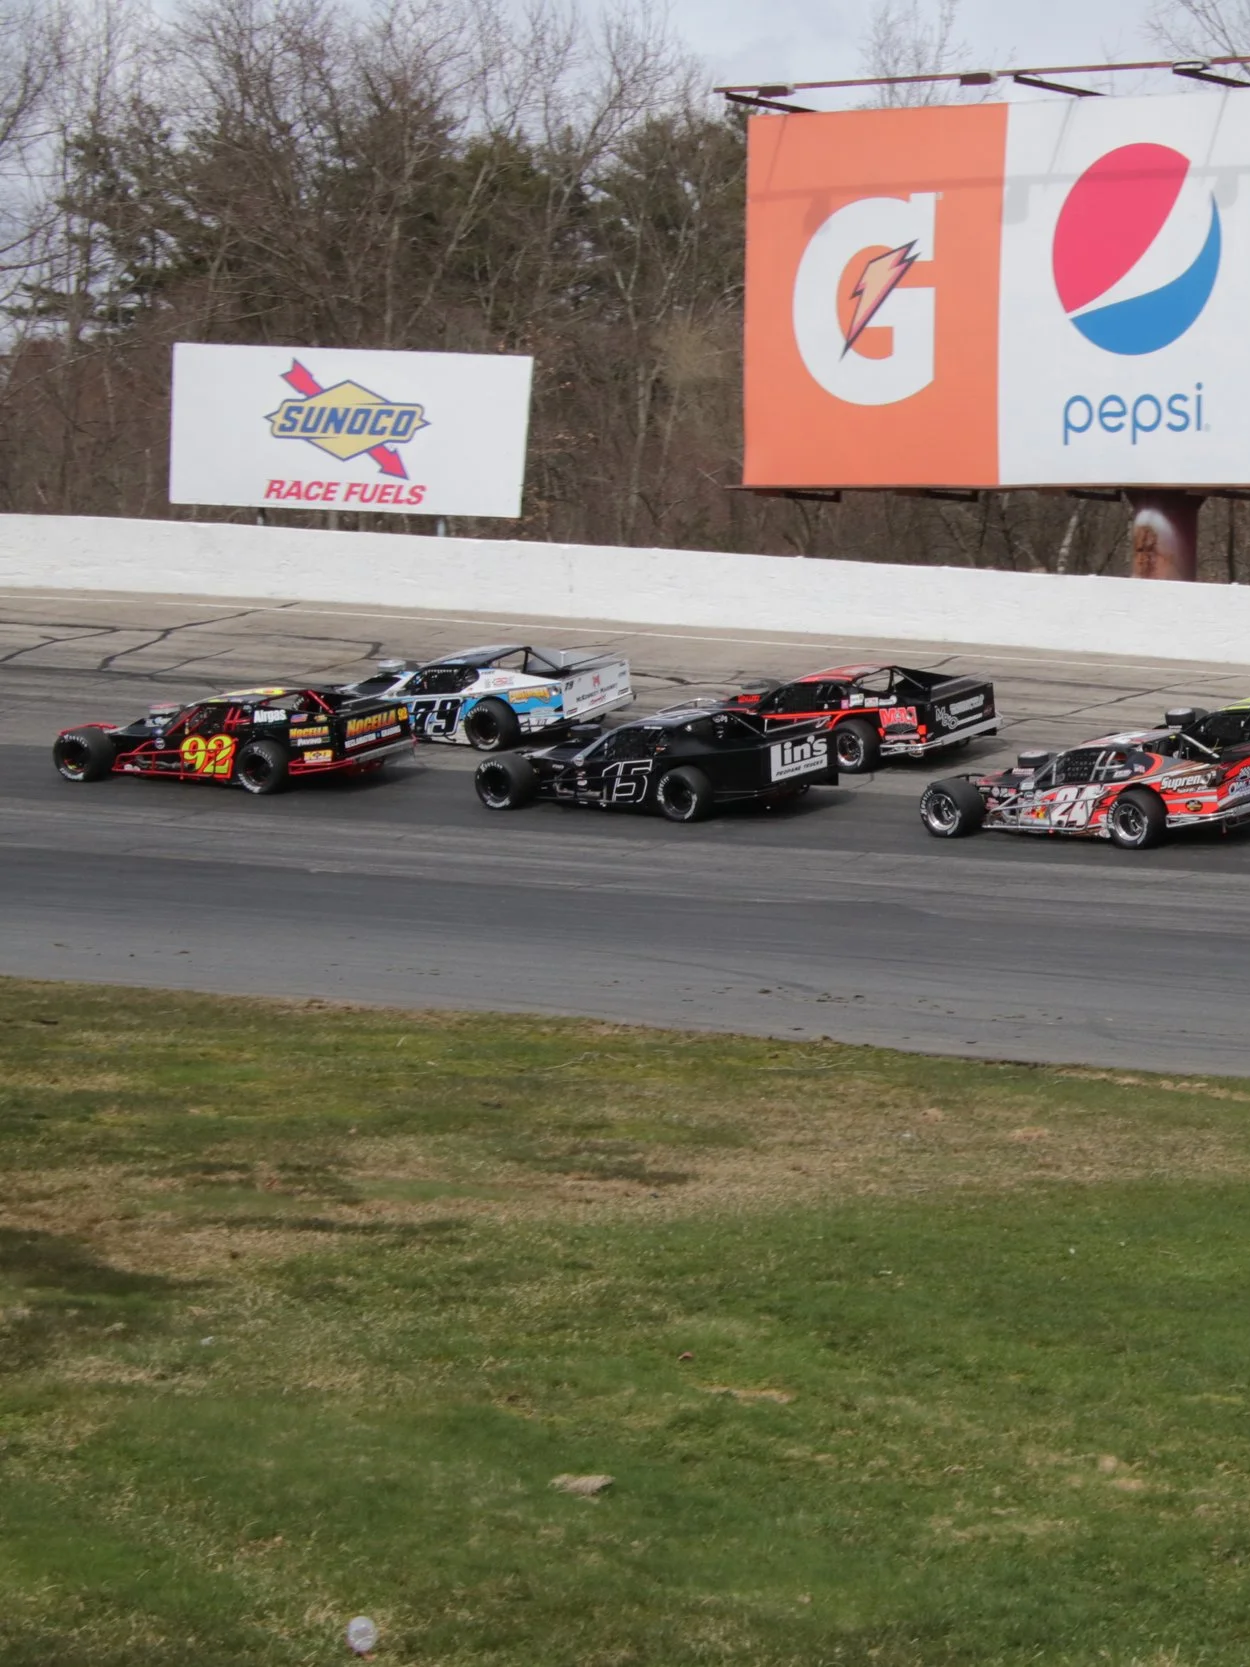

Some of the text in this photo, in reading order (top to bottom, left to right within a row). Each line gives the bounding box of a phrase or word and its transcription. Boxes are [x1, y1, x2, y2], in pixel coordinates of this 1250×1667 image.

[792, 192, 936, 406] G
[279, 405, 416, 437] SUNOCO
[1063, 382, 1203, 446] pepsi
[264, 479, 426, 506] RACE FUELS
[253, 709, 287, 724] Airgas
[412, 698, 461, 737] 79
[179, 733, 236, 779] 92
[602, 759, 653, 803] 15
